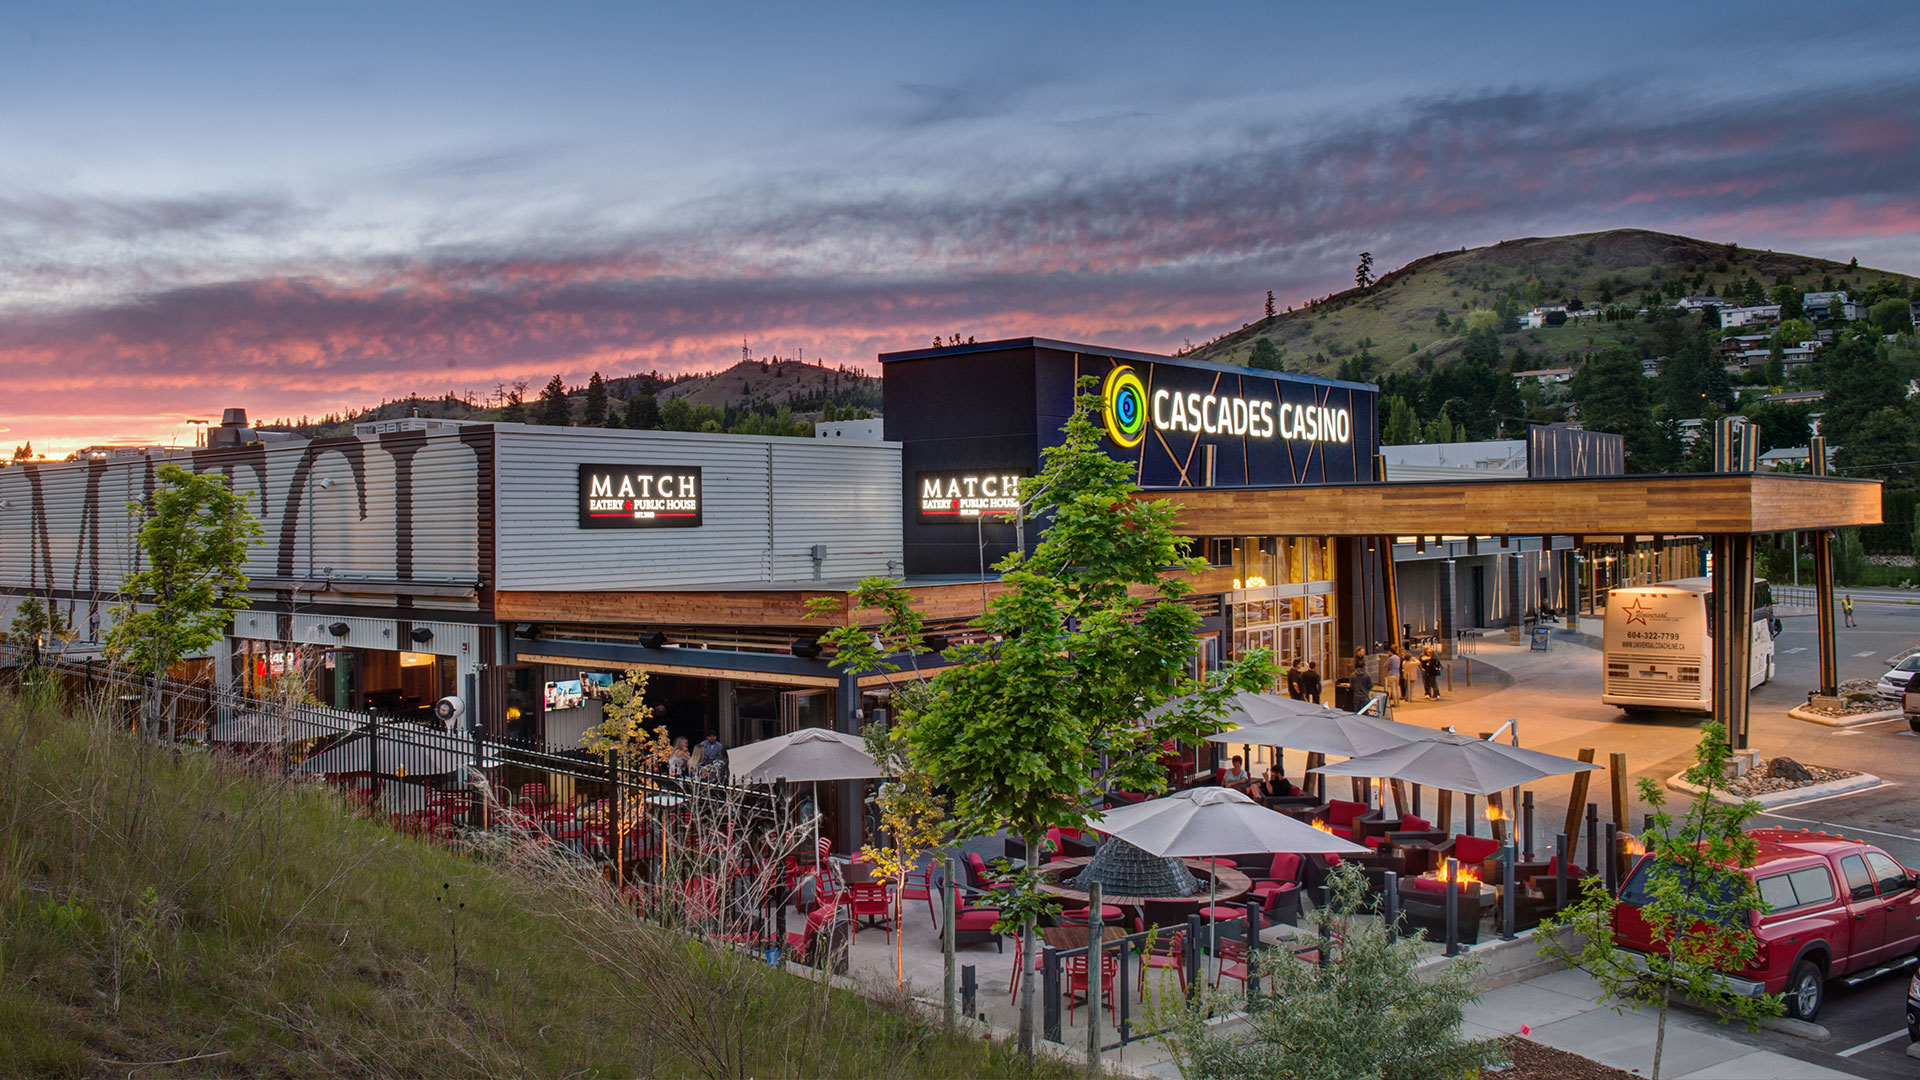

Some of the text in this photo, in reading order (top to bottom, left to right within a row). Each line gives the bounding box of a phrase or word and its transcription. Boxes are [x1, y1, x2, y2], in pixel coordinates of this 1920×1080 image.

[1153, 389, 1350, 444] CASCADES CASINO
[589, 474, 696, 498] MATCH
[922, 475, 1020, 498] MATCH
[589, 499, 696, 511] EATERY & PUBLIC HOUSE
[922, 499, 952, 510] EATERY
[960, 497, 989, 509] PUBLIC
[1627, 631, 1680, 640] 604-322-7799
